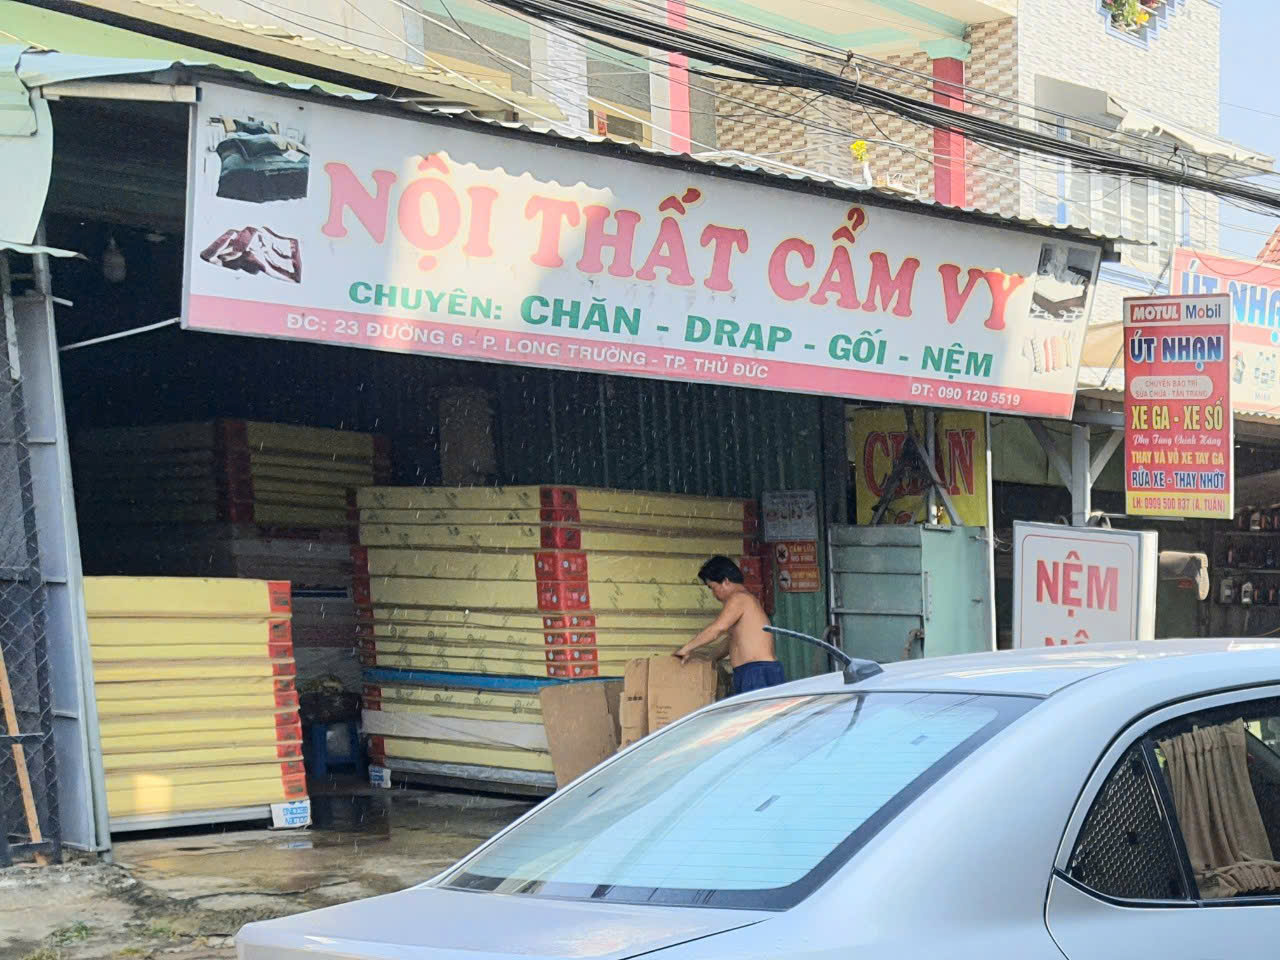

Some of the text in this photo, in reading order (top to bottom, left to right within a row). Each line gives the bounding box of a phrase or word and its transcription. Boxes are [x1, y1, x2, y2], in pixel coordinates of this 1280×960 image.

[321, 151, 1026, 331] NỘI THẤT CẨM VY
[348, 280, 994, 380] CHUYÊN: CHĂN DRAP GỐI NỆM
[1133, 304, 1221, 320] MOTUL Mobil
[287, 312, 769, 379] ĐC: 23 ĐƯỜNG 6 P. LONG TRƯỜNG TP. THỦ ĐỨC
[1130, 329, 1224, 372] ÚT NHẠN
[911, 383, 1021, 406] ĐT: 090 120 5519
[1131, 396, 1223, 431] XE GA XE SỐ
[1131, 451, 1152, 465] THAY
[1181, 451, 1193, 465] XE
[1194, 452, 1210, 465] TAY
[1211, 452, 1224, 465] GA
[1131, 465, 1226, 490] RỬA XE THAY NHỚT
[1036, 550, 1119, 618] NỆM
